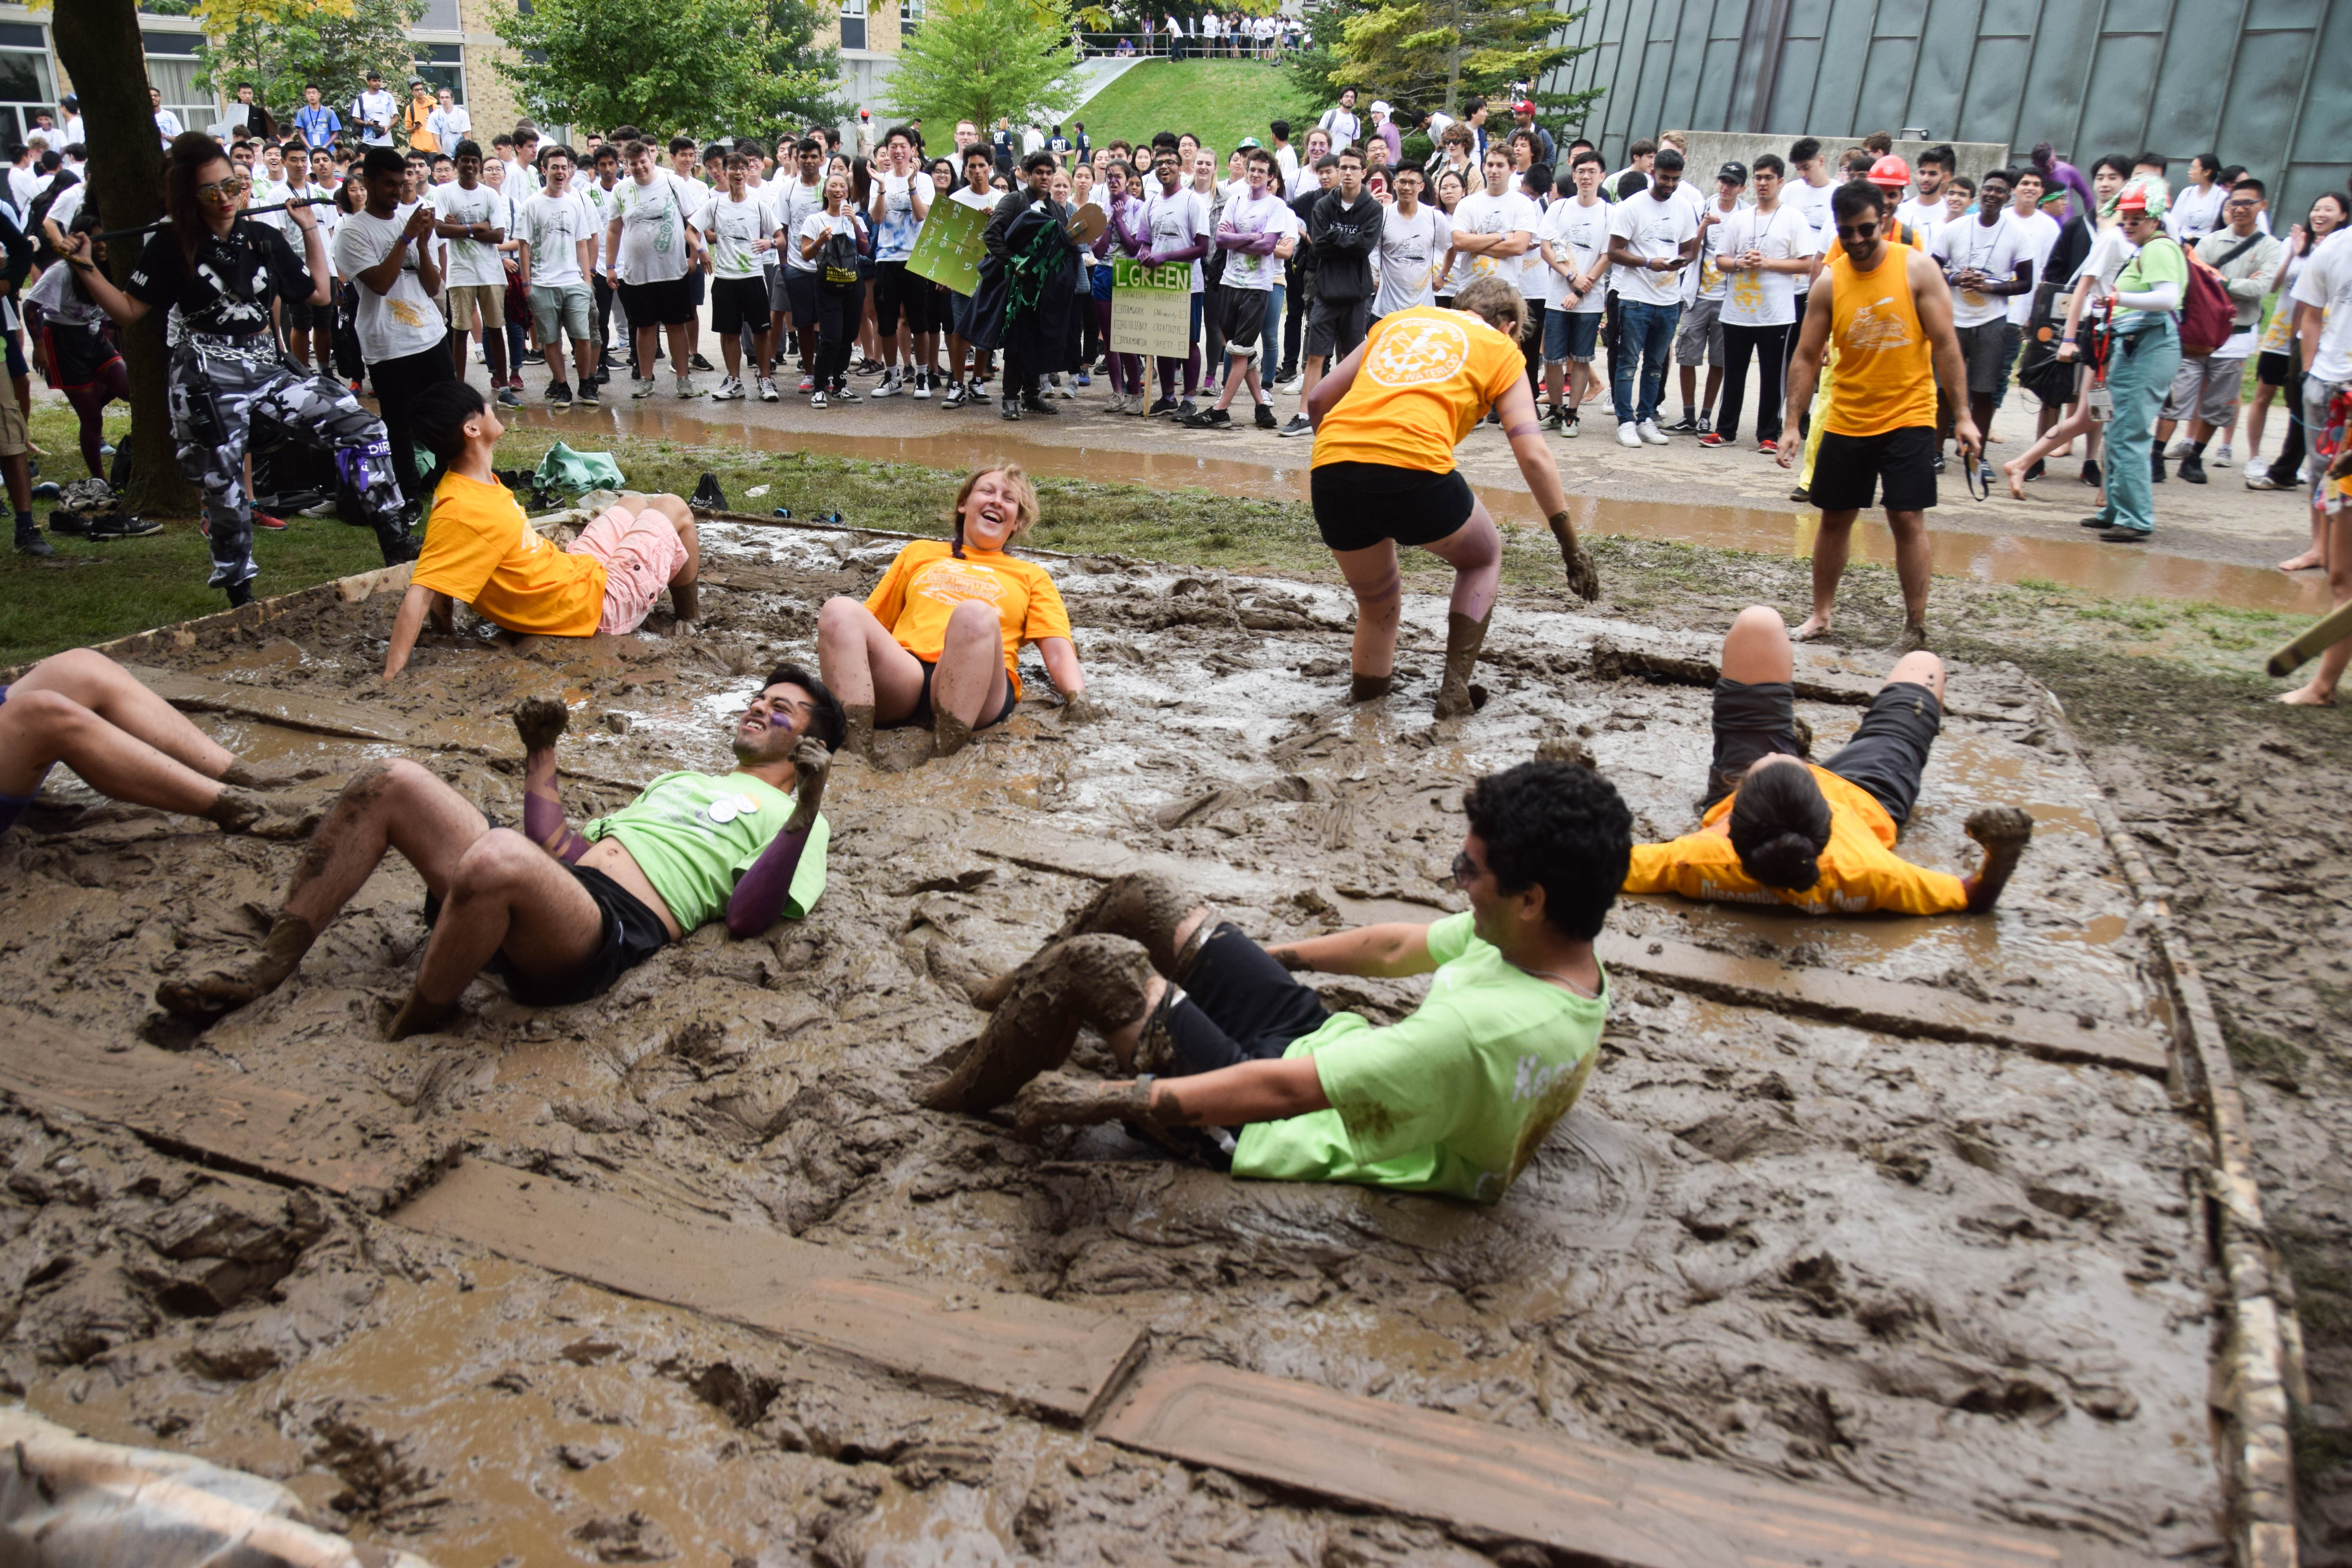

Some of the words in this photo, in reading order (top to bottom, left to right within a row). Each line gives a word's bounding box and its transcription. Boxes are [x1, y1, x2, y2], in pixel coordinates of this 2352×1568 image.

[994, 132, 1005, 142] CRT
[1052, 139, 1066, 149] CRT
[1129, 265, 1188, 290] GREEN
[1122, 291, 1148, 300] KNOWLEDGE
[1155, 292, 1180, 302] INTEGRITY
[1122, 305, 1145, 315] TEAMWORK
[1122, 320, 1147, 331] RESILIENCY
[1153, 323, 1180, 334] CREATIVITY
[1401, 321, 1462, 342] ENGINEERING
[1154, 340, 1173, 349] SAFETY
[1386, 373, 1401, 382] OF
[1405, 354, 1459, 381] WATERLOO
[927, 572, 999, 593] DESTINATION
